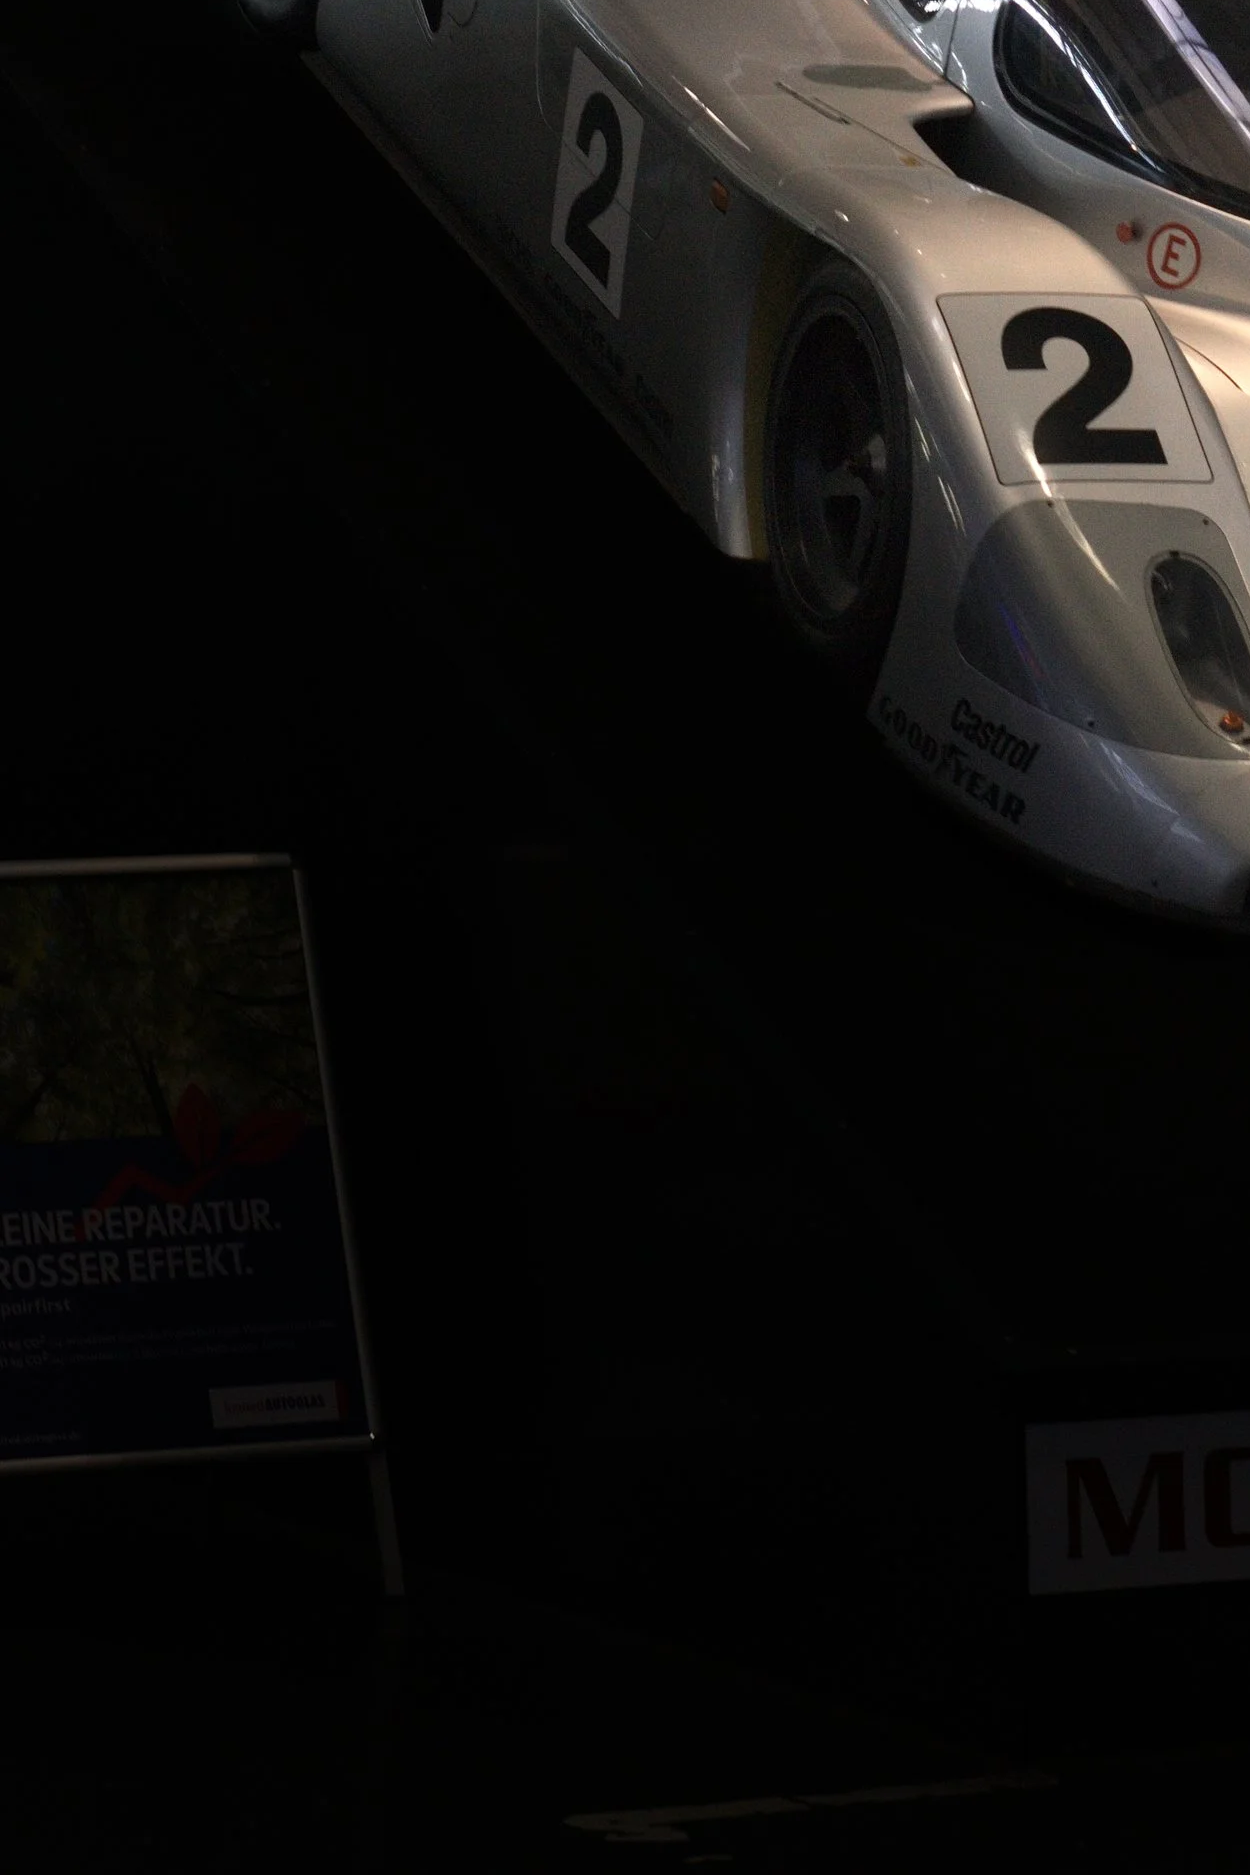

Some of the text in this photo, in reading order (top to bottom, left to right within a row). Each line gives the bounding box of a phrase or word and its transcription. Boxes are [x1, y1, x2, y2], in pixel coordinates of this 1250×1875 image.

[566, 91, 625, 289] 2
[1160, 233, 1188, 278] E
[1001, 307, 1168, 465] 2
[951, 698, 1040, 774] Castrol
[0, 1197, 282, 1247] EINE REPARATUR.
[125, 1242, 256, 1283] EFFEKT.
